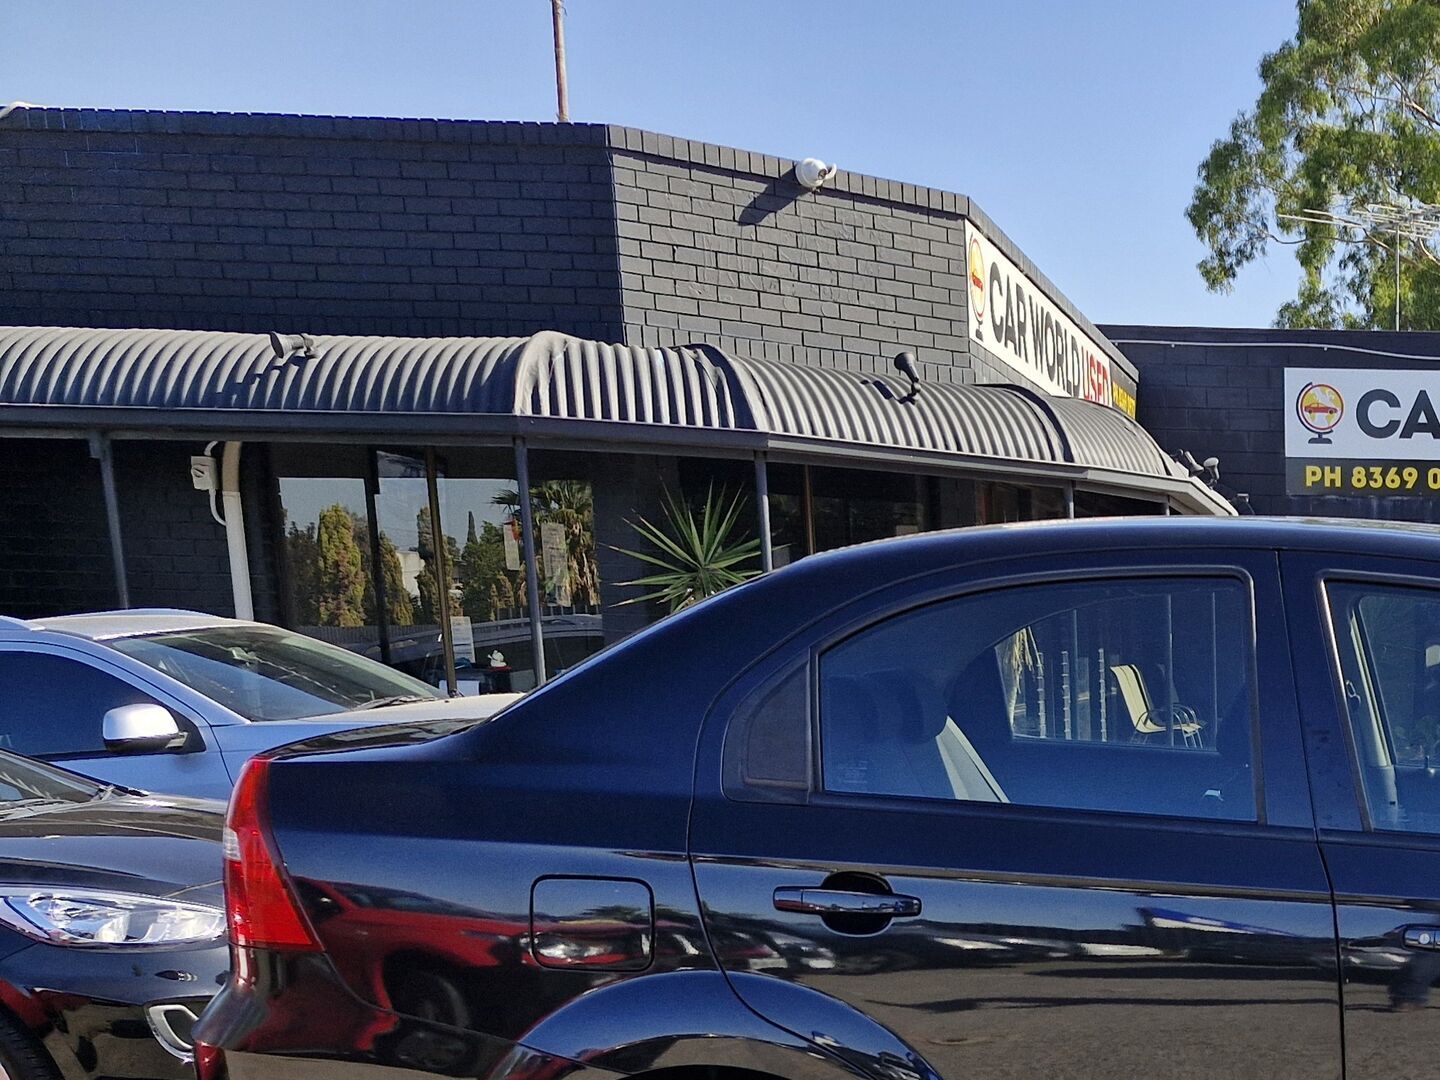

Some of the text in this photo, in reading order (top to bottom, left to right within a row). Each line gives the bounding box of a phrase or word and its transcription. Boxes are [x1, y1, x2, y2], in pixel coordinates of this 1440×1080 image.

[989, 261, 1029, 364] CAR
[1029, 294, 1081, 398] WORLD
[1305, 465, 1342, 488] PH
[1351, 466, 1419, 490] 8369
